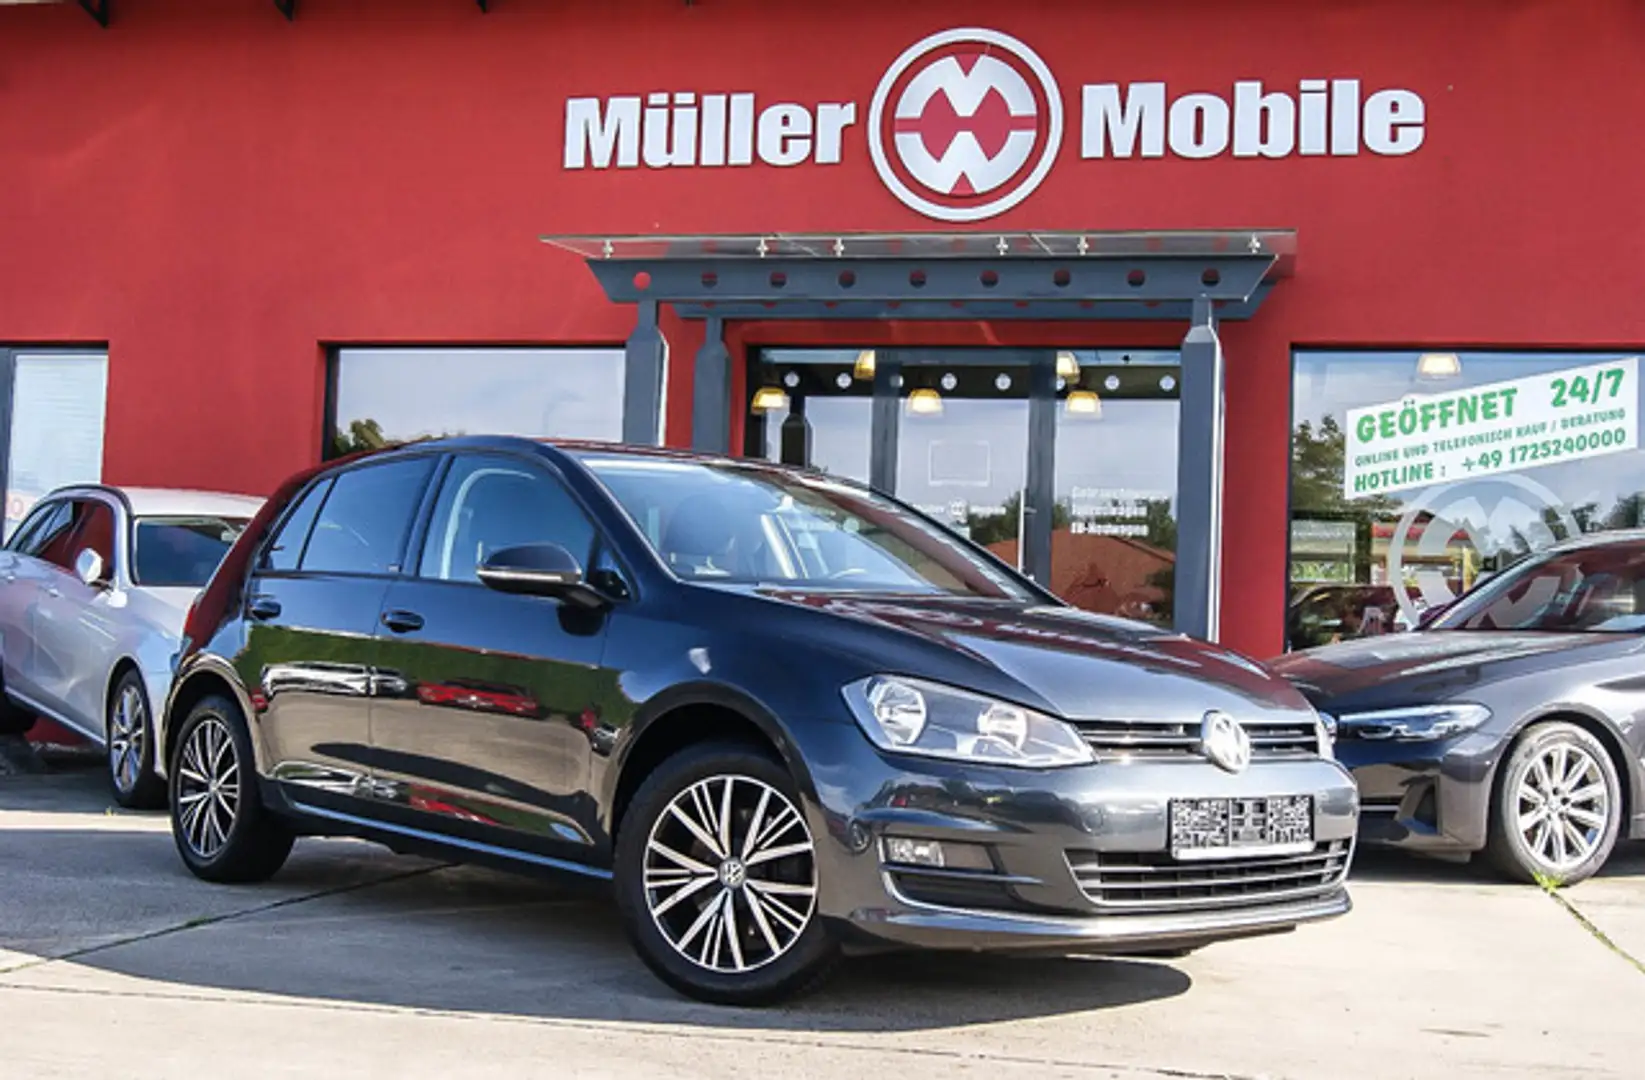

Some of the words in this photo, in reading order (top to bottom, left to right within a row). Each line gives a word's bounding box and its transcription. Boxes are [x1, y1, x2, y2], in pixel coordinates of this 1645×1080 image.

[563, 91, 857, 169] Müller
[1081, 78, 1426, 159] Mobile
[1355, 387, 1519, 443] GEÖFFNET
[1549, 367, 1625, 408] 24/7
[1354, 447, 1399, 467] ONLINE
[1403, 443, 1429, 459] UND
[1432, 427, 1513, 453] TELEFONISCH
[1354, 461, 1434, 493] HOTLINE
[1460, 449, 1503, 472] +49
[1509, 426, 1626, 464] 1725240000
